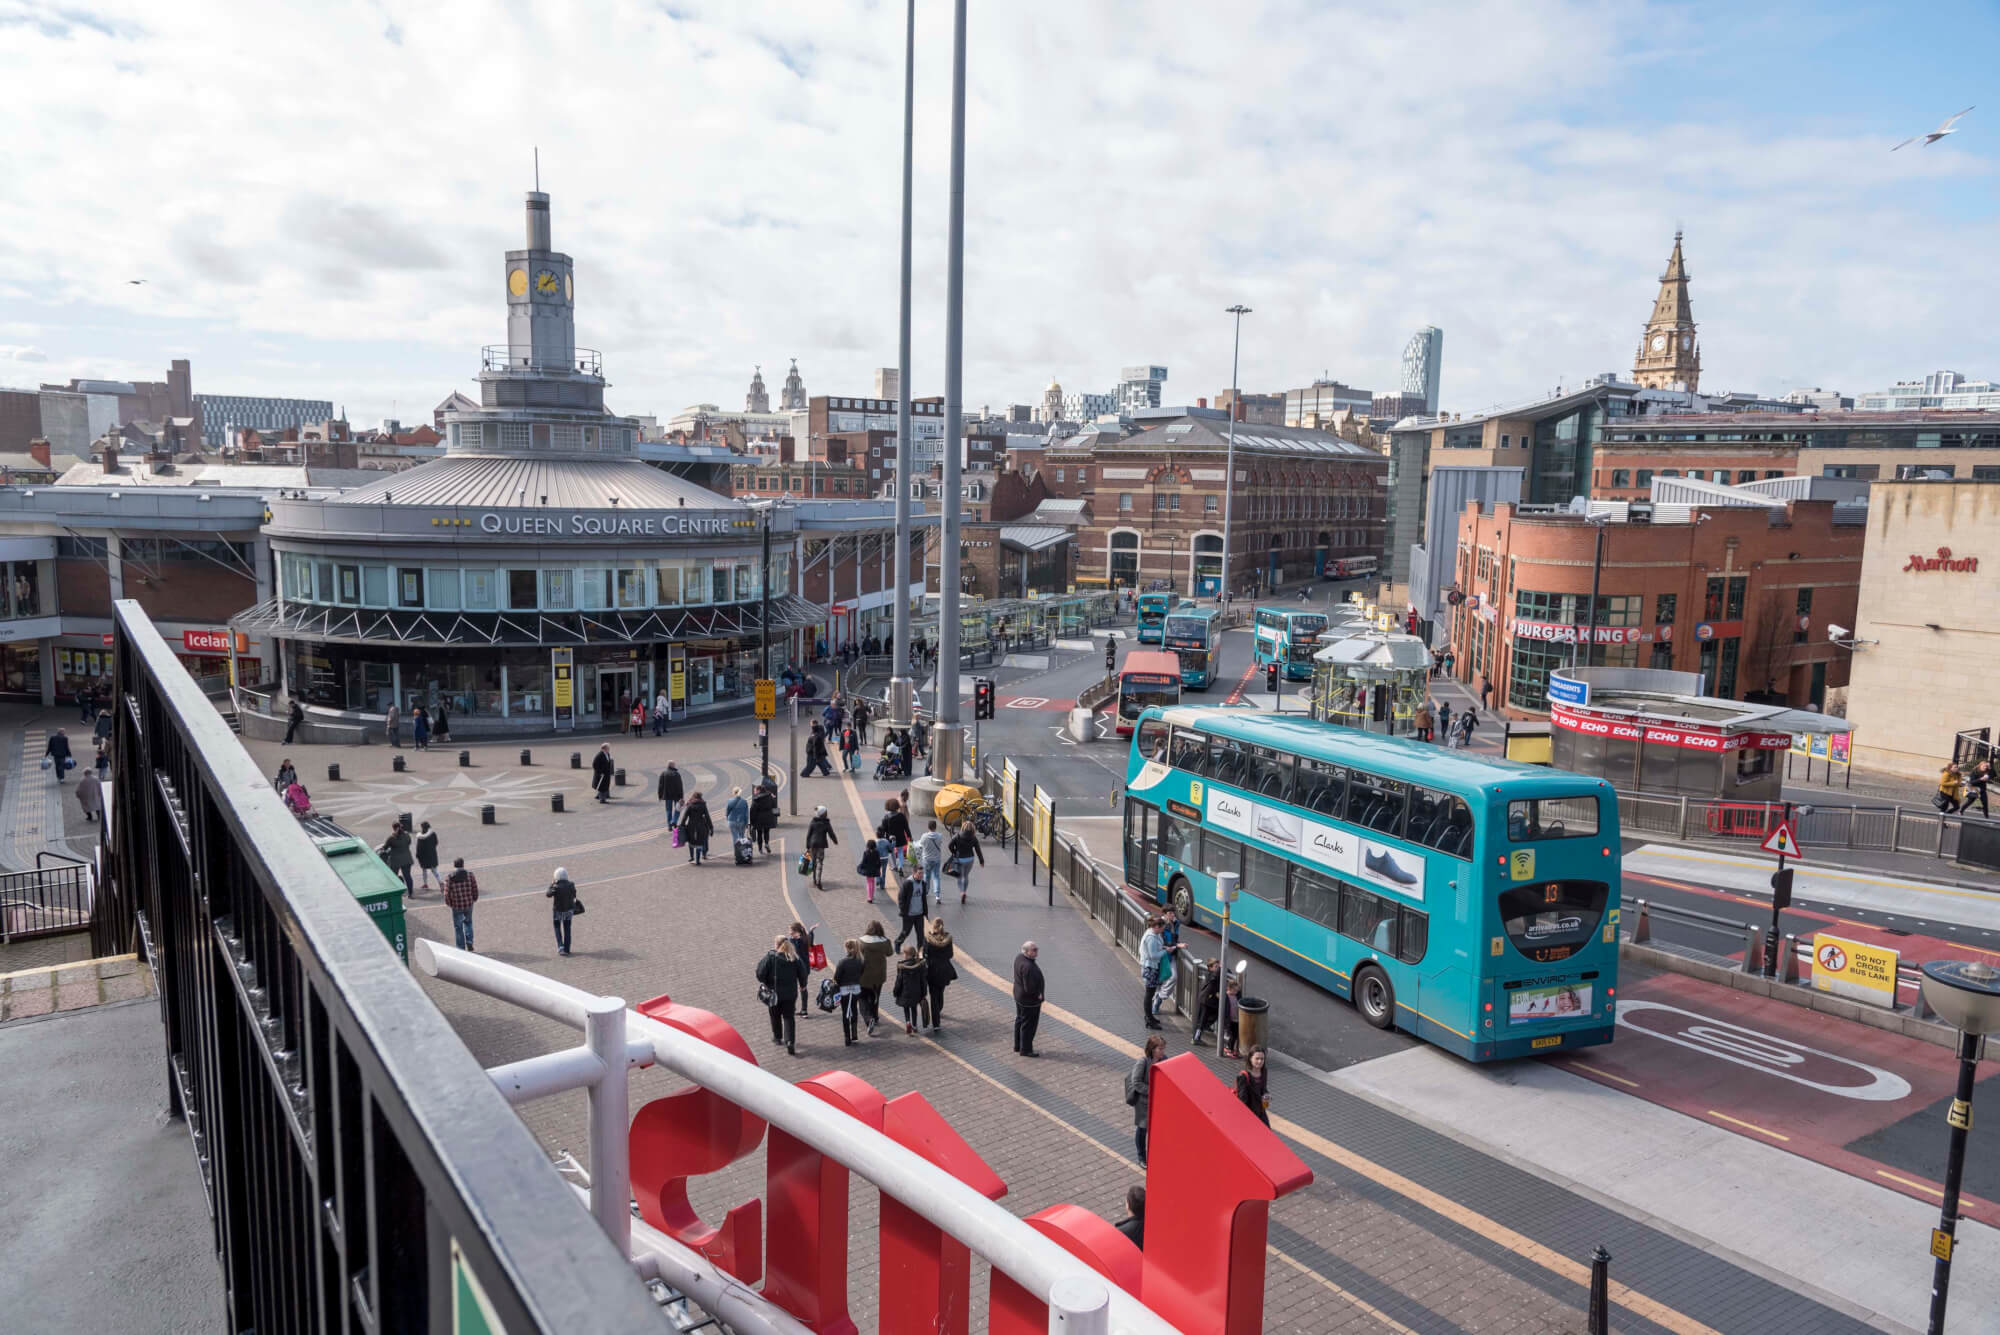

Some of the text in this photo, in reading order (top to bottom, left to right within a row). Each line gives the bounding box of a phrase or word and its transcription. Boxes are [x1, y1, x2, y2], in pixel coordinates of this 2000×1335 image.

[481, 513, 729, 534] QUEEN SQUARE CENTRE
[1903, 553, 1977, 573] Marriott
[1518, 623, 1576, 640] BURGER
[1580, 628, 1623, 642] KING
[1581, 721, 1608, 733] ECHO
[1647, 730, 1679, 742] ECHO
[1684, 735, 1718, 748] ECHO
[1760, 737, 1789, 747] ECHO
[1217, 800, 1241, 818] Clarks
[1314, 834, 1344, 855] Clarks
[1544, 884, 1558, 904] 13
[1855, 953, 1887, 966] DO NOT
[1856, 961, 1885, 973] CROSS
[1850, 967, 1889, 982] BUS LANE
